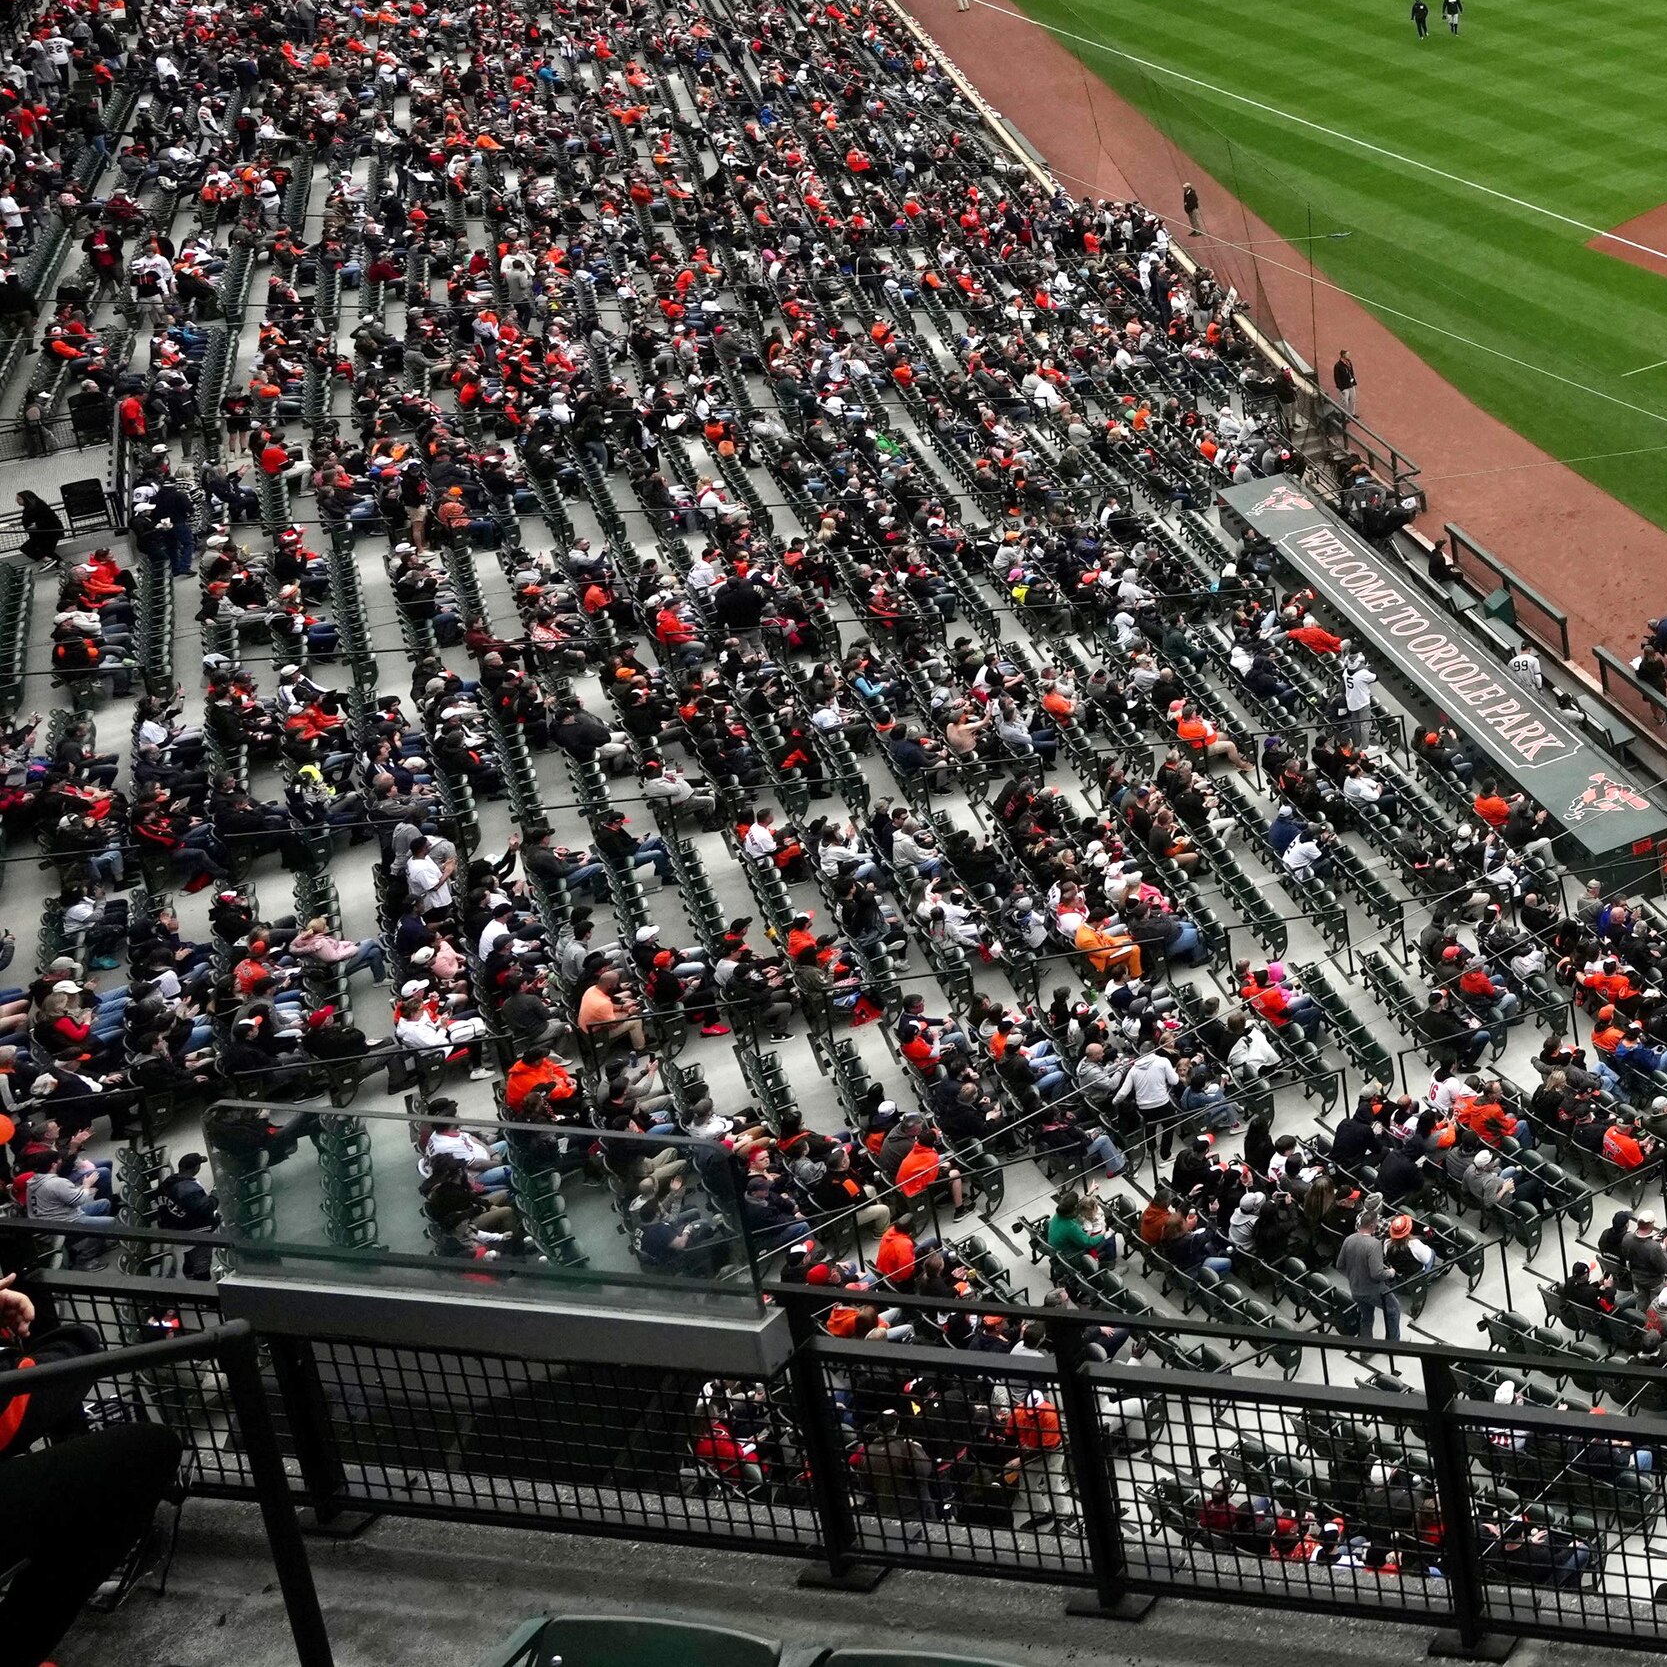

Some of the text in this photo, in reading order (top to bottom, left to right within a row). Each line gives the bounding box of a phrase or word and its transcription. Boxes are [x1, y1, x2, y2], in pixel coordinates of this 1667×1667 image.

[1296, 528, 1566, 762] WELCOME TO ORIOLE PARK
[1514, 660, 1528, 672] 99
